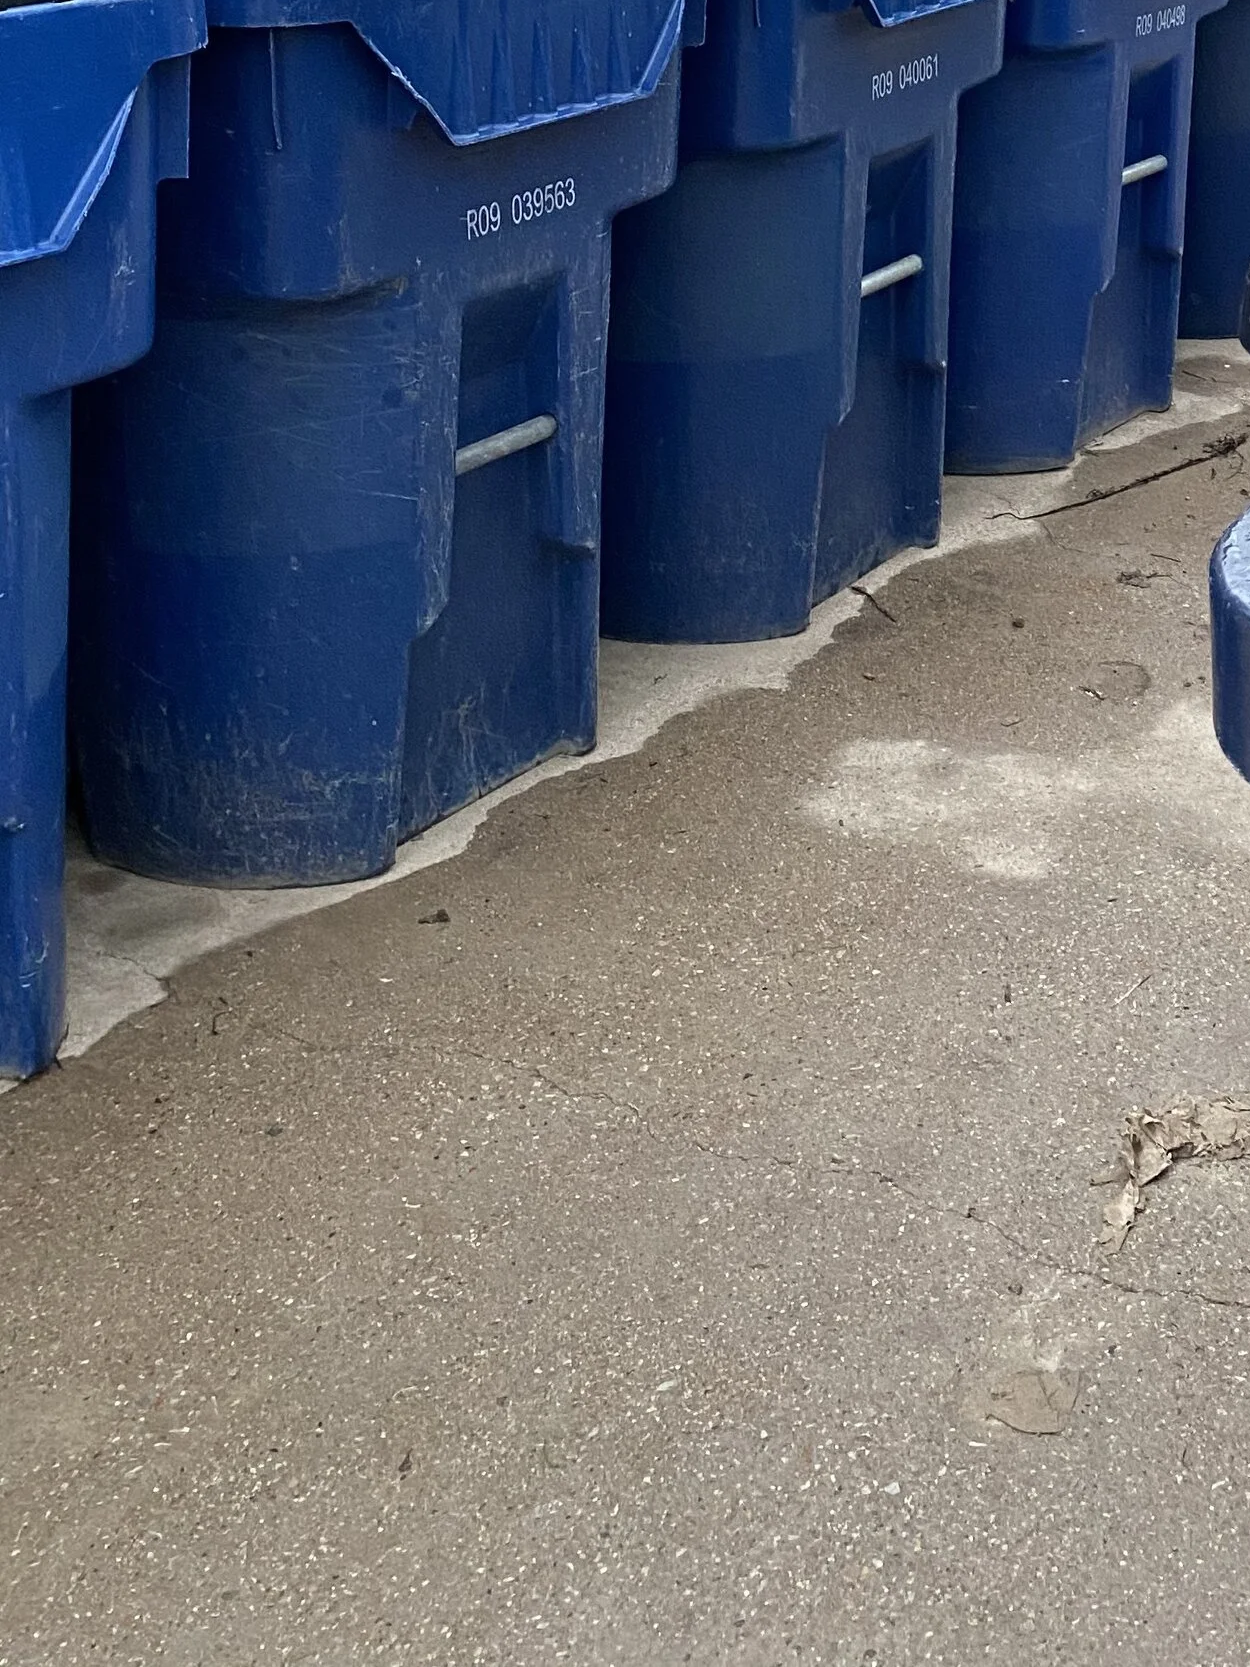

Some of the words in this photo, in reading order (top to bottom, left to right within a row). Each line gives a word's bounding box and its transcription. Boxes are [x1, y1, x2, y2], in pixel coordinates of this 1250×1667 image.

[1136, 13, 1153, 37] R09
[872, 71, 893, 101] R09
[899, 53, 938, 89] 040061
[467, 202, 501, 240] R09
[512, 177, 576, 224] 039563
